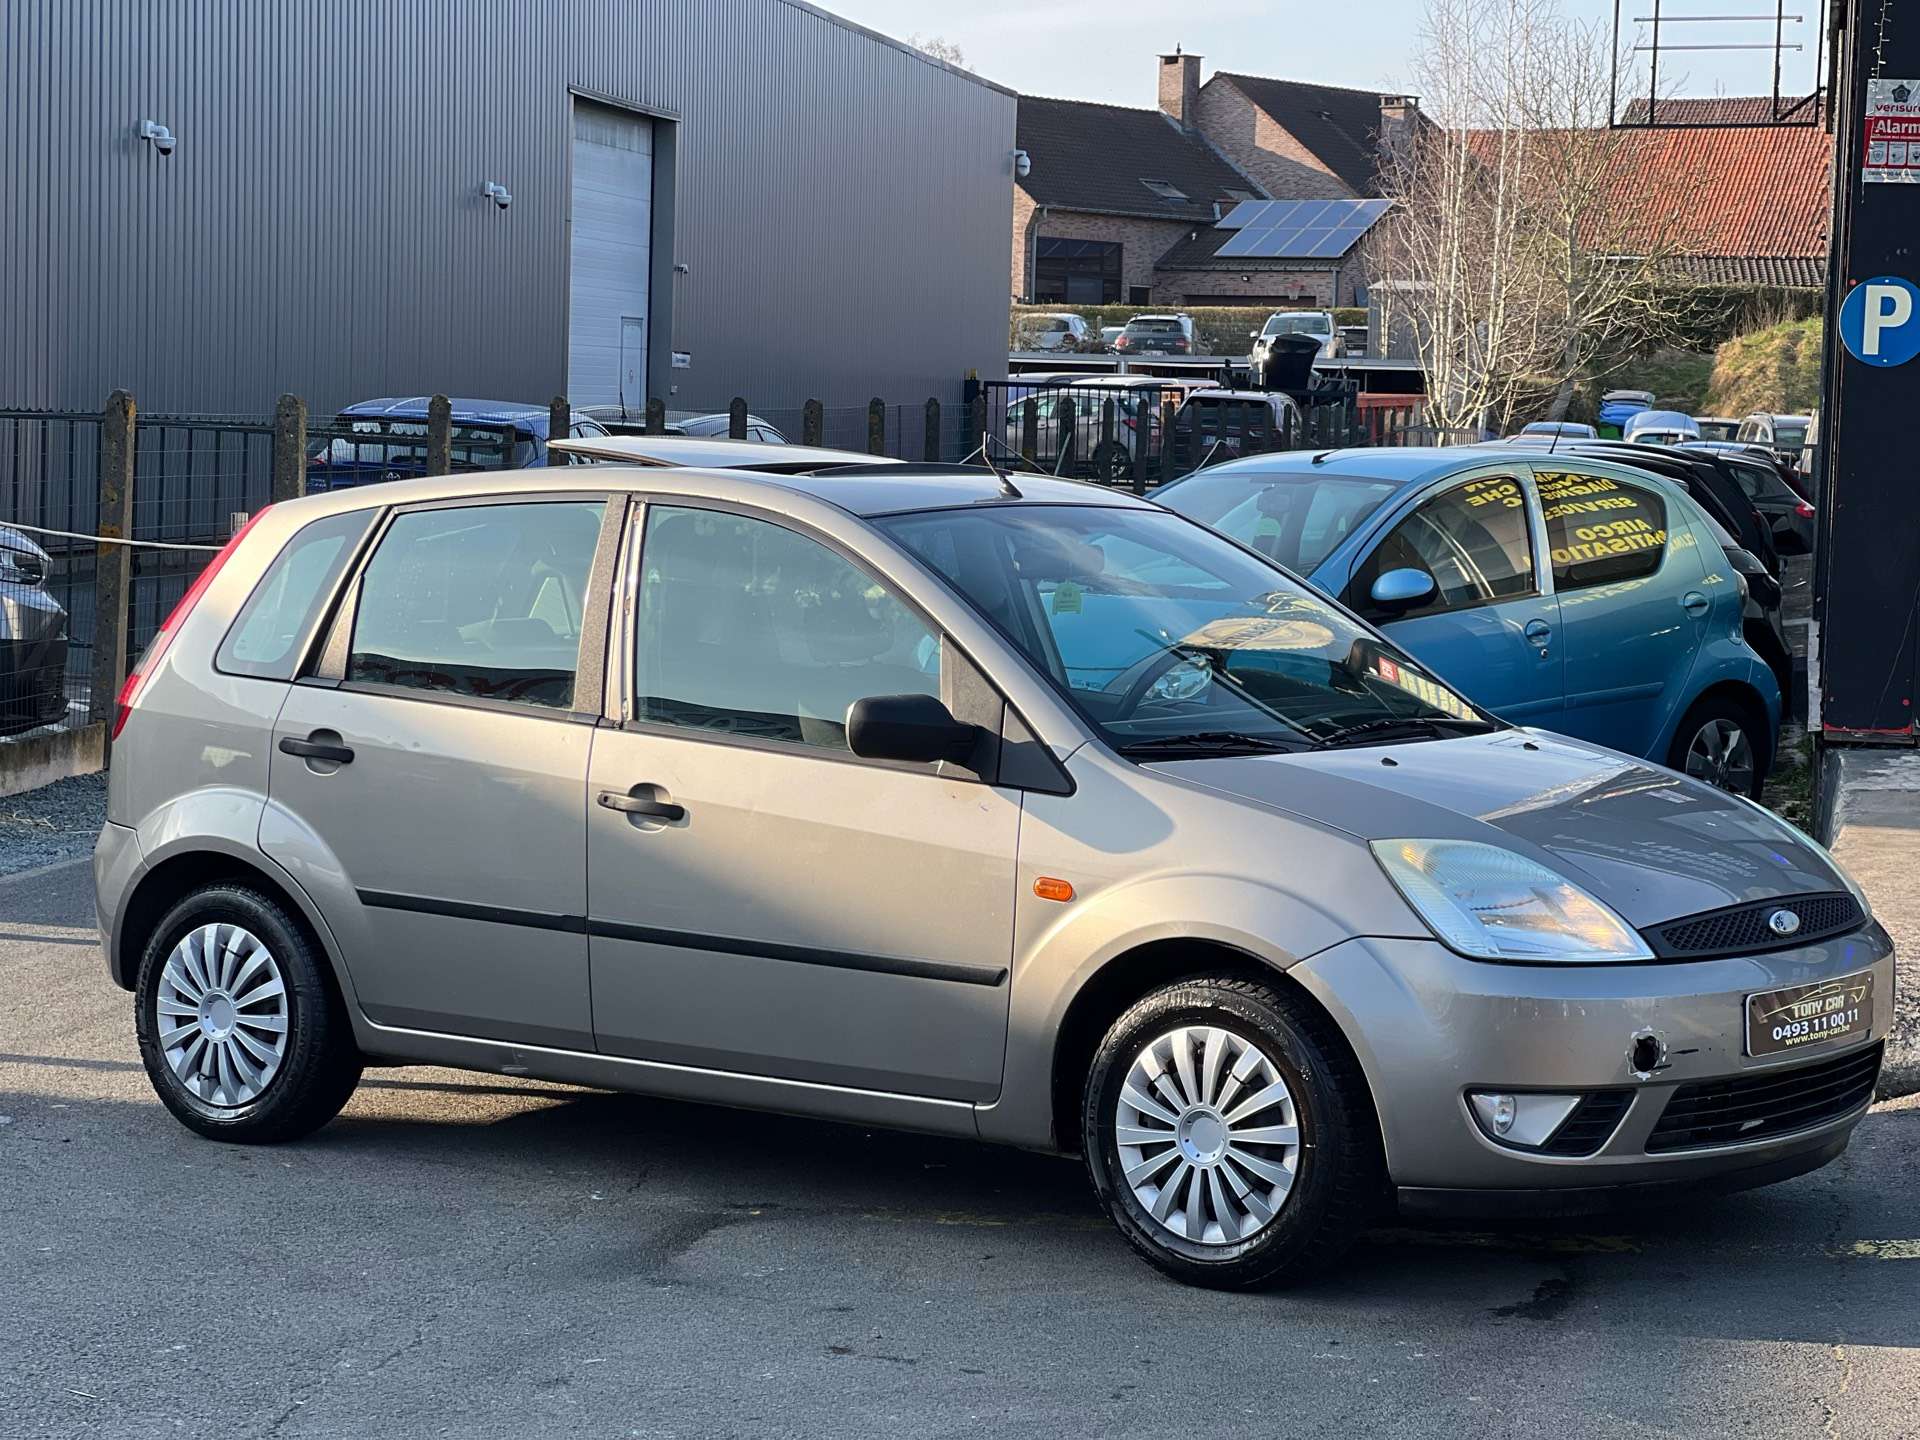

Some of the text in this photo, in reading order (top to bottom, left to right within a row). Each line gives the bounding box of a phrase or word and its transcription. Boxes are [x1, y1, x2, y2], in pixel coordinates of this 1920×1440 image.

[1876, 103, 1920, 112] verisur
[1876, 119, 1920, 133] Alarm
[1863, 285, 1912, 355] P
[1791, 1001, 1823, 1018] TONY
[1772, 1021, 1809, 1040] 0493
[1785, 1024, 1850, 1046] www.tony-car.be
